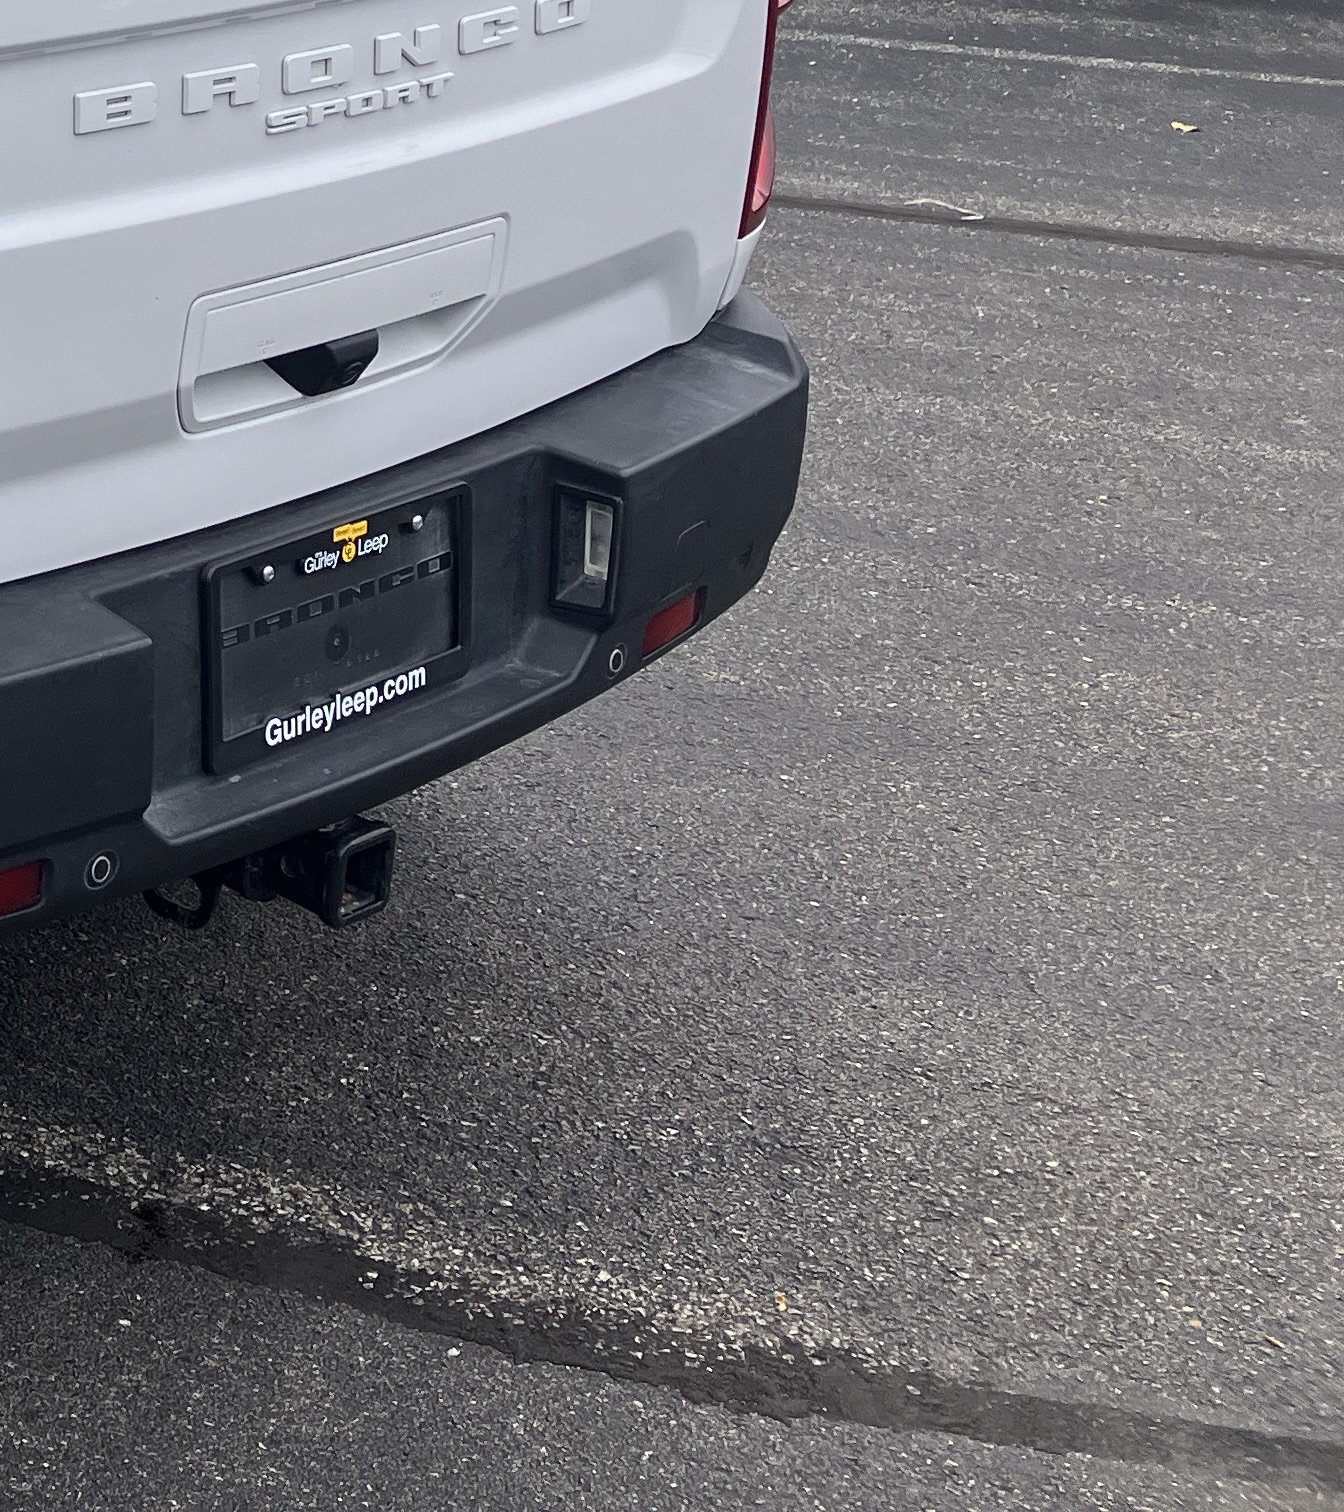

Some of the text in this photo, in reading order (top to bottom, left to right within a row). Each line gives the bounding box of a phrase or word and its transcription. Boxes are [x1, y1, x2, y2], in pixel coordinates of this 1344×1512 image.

[264, 71, 456, 136] SPORT
[304, 550, 340, 574] Gurley
[357, 533, 389, 556] Leep
[221, 551, 451, 649] BRONCO
[264, 666, 427, 747] Gurleyleep.com
